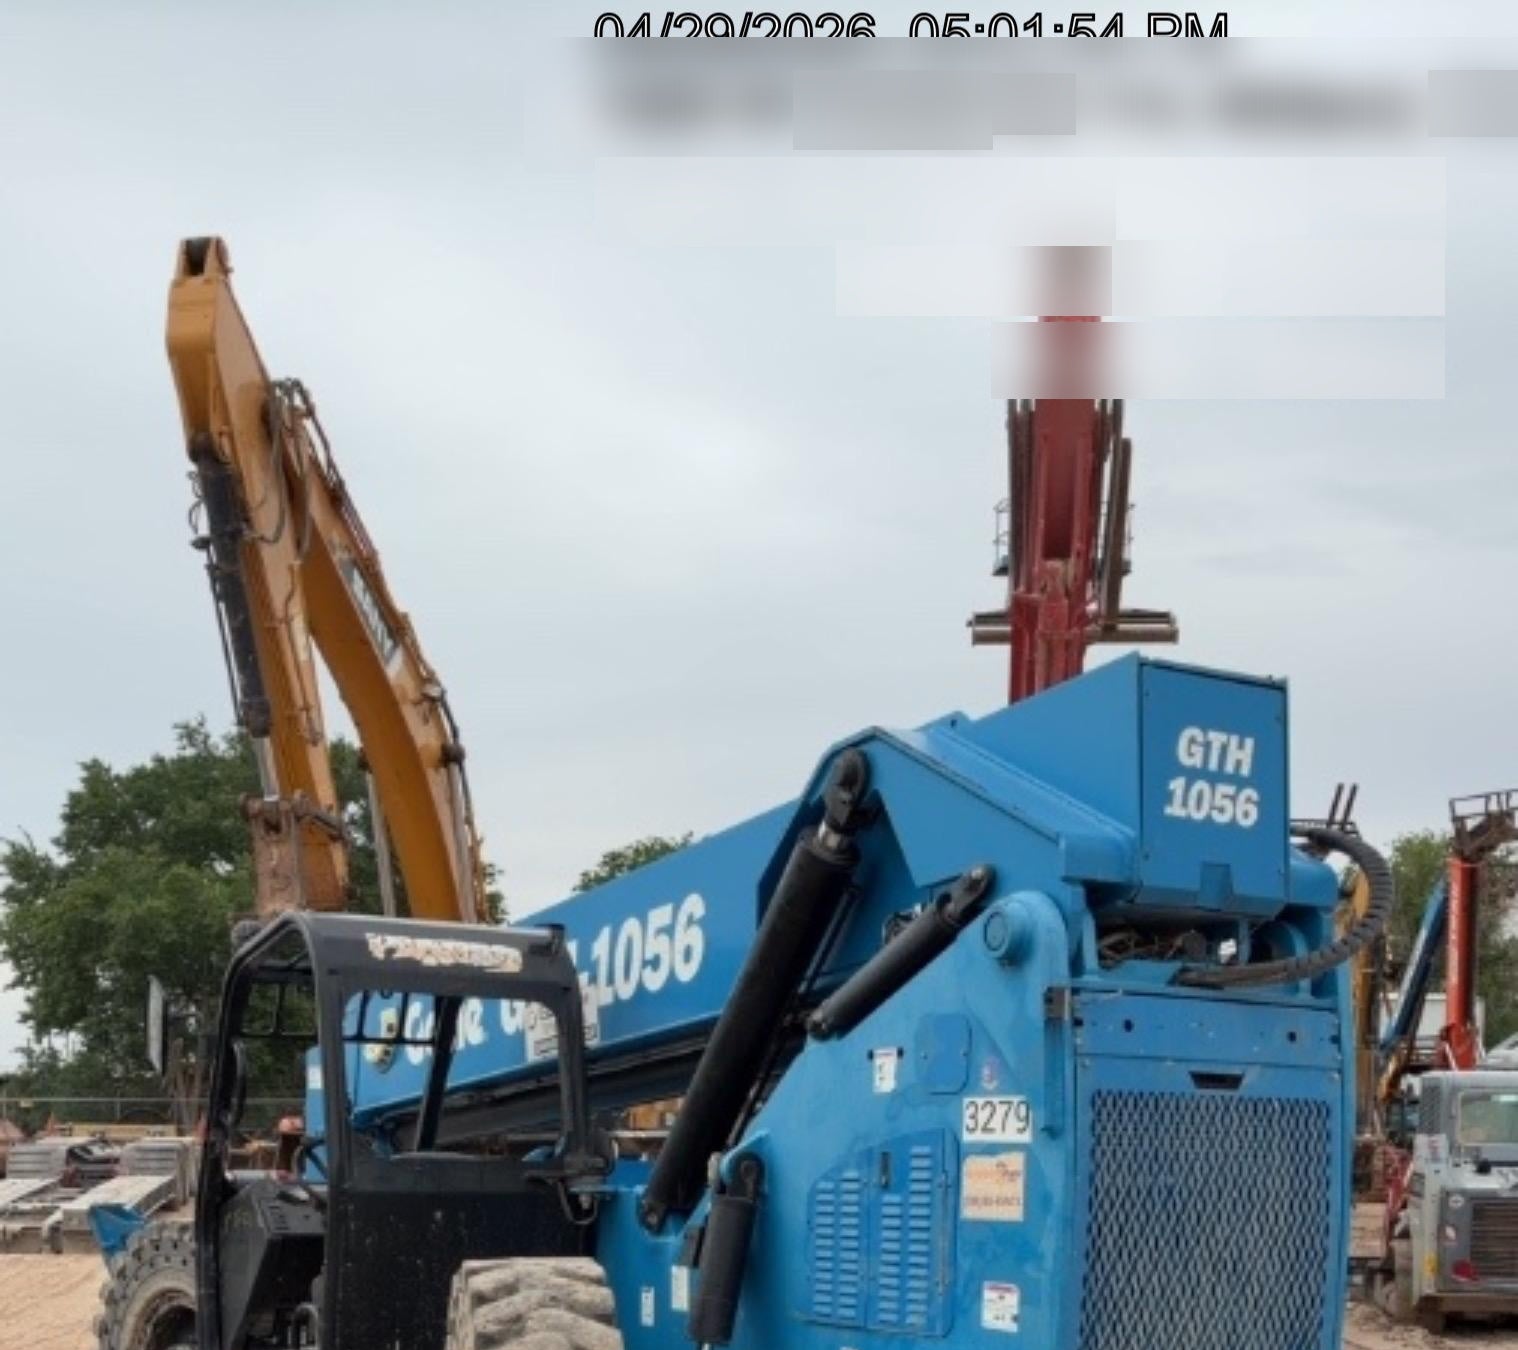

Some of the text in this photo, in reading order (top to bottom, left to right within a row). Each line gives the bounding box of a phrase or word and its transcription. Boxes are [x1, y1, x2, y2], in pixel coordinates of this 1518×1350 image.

[1177, 725, 1255, 776] GTH
[1163, 776, 1260, 828] 1056
[965, 1100, 1030, 1134] 3279
